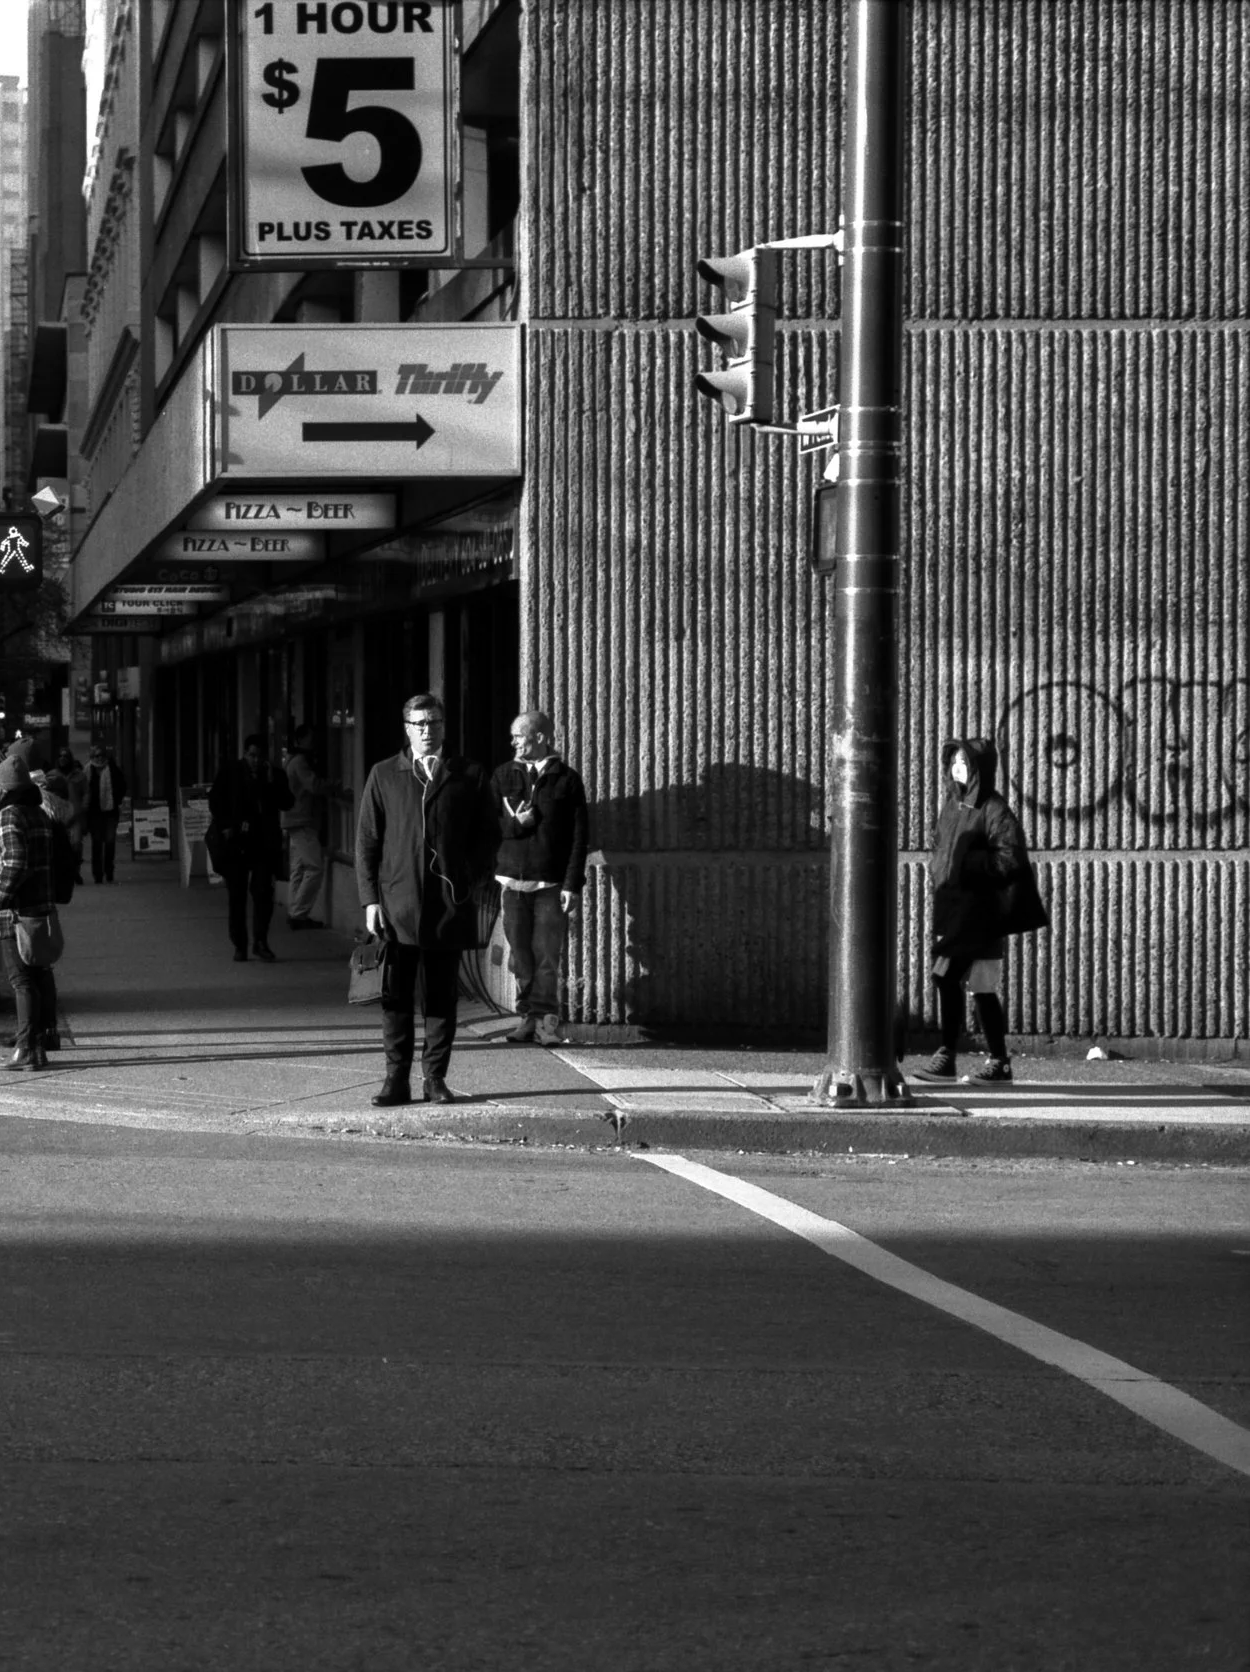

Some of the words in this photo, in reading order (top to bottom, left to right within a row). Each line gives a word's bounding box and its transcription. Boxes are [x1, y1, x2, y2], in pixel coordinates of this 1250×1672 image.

[254, 3, 274, 35] 1
[296, 2, 434, 34] HOUR
[258, 221, 331, 242] PLUS
[340, 220, 433, 241] TAXES
[239, 372, 372, 393] DOLLAR
[395, 363, 504, 405] Thrifty
[225, 501, 281, 520] PIZZA
[306, 501, 356, 520] BEER
[183, 536, 230, 552] PIZZA
[250, 536, 291, 552] BEER
